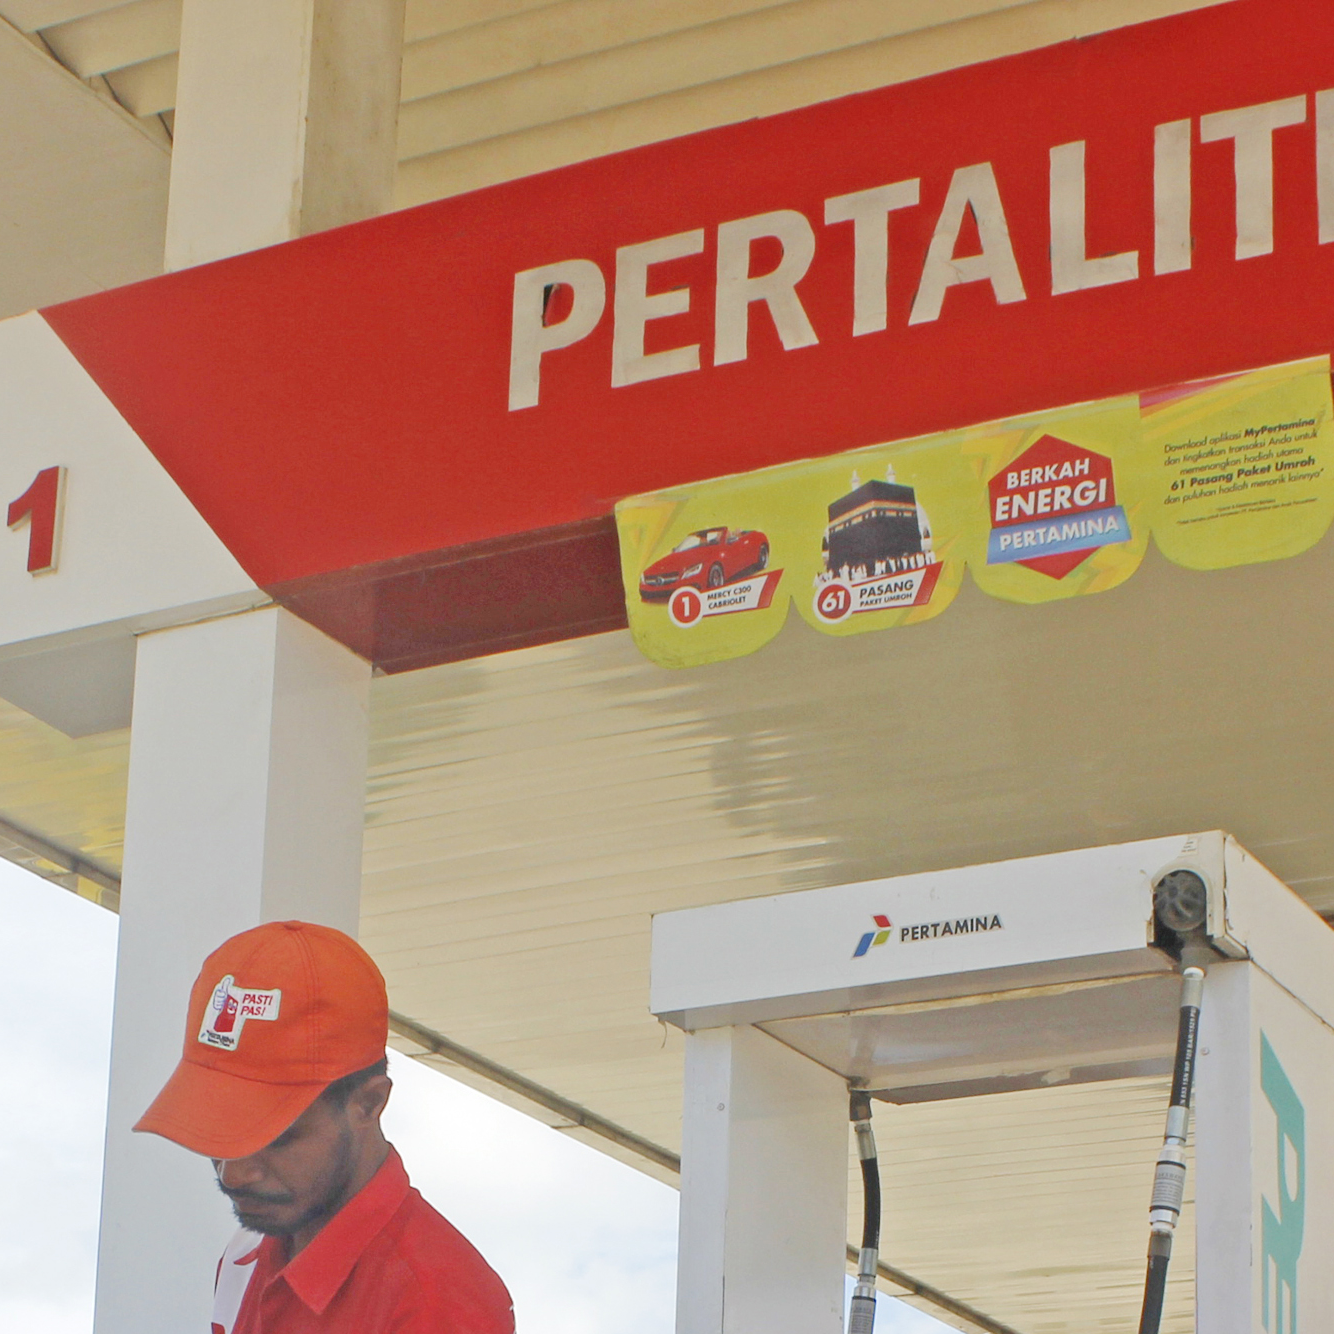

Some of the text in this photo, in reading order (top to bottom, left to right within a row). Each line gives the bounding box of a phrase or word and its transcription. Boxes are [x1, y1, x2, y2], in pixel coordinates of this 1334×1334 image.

[1164, 418, 1315, 453] Download aplikasi MyPertamina
[1164, 430, 1317, 466] dan tingkatkan transaksi Anda untuk
[1007, 457, 1090, 490] BERKAH
[1171, 456, 1315, 491] 61 Pasang Paket Umroh
[1180, 447, 1304, 475] memenangkan hadiah utama
[995, 478, 1107, 522] ENERGI
[1164, 494, 1179, 504] dan
[1182, 487, 1216, 503] puluhan
[1218, 482, 1248, 494] hadiah
[1250, 475, 1286, 488] menarik
[7, 465, 65, 575] 1
[1000, 515, 1120, 551] PERTAMINA
[707, 585, 751, 601] MERCY C300
[708, 595, 746, 610] CABRIOLET
[821, 590, 846, 613] 61
[859, 579, 914, 599] PASANG
[859, 592, 913, 608] PAKET UMROH
[682, 596, 690, 617] 1
[901, 915, 1002, 942] PERTAMINA
[240, 1005, 266, 1017] PAS!
[242, 993, 273, 1006] PASTI
